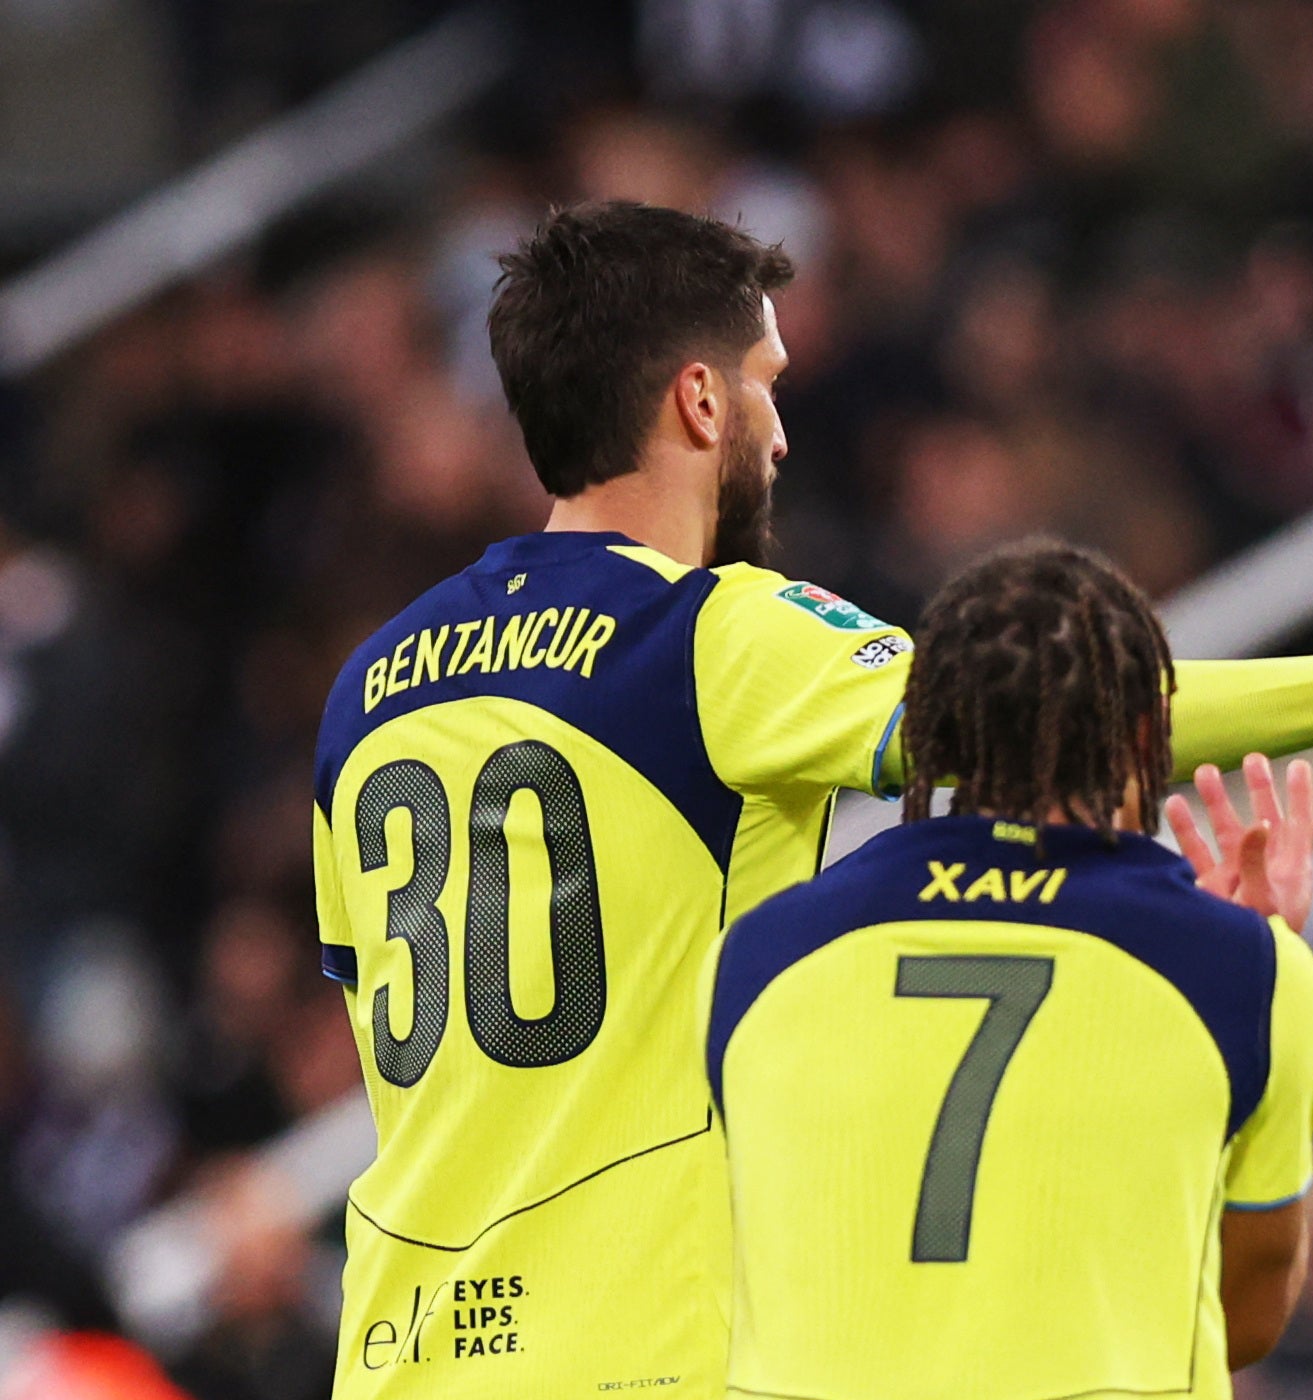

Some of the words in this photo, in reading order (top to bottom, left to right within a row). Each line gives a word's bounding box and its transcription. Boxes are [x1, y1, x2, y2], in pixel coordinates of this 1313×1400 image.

[364, 606, 616, 714] BENTANCUR
[919, 861, 1068, 904] XAVI
[354, 738, 608, 1089] 30
[894, 953, 1056, 1264] 7
[454, 1276, 530, 1301] EYES.
[454, 1305, 518, 1330] LIPS.
[454, 1332, 525, 1359] FACE.
